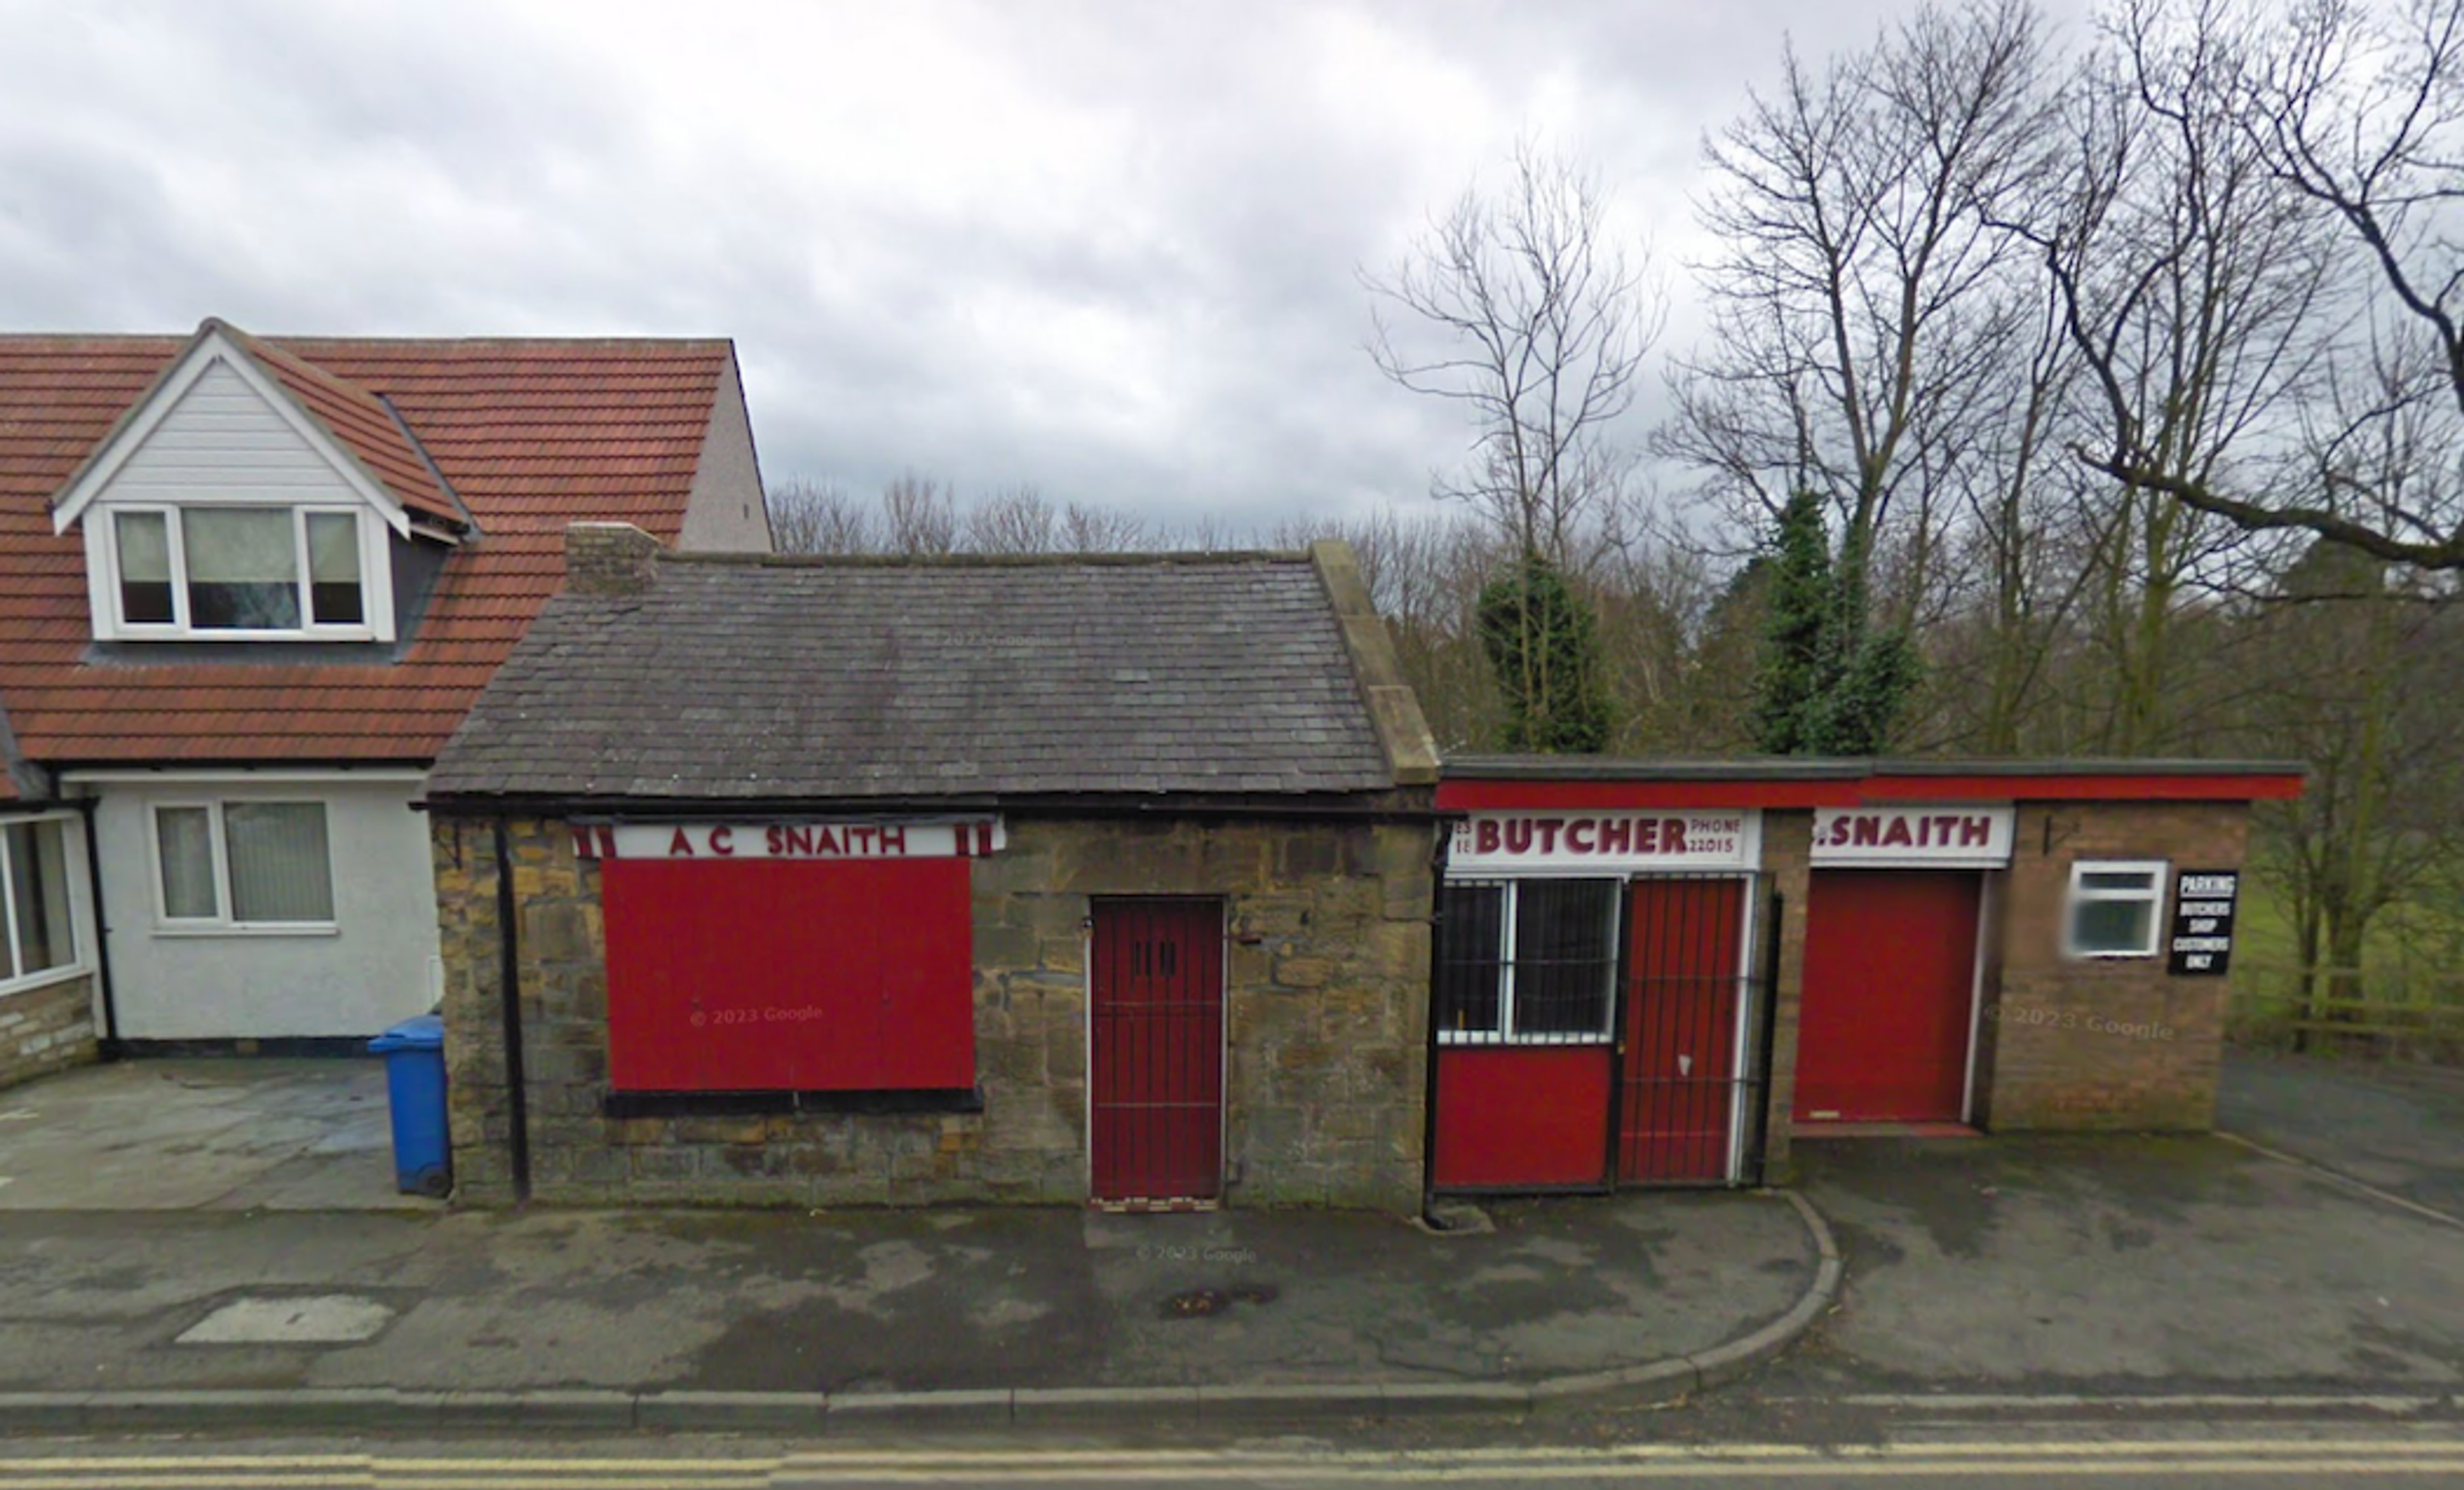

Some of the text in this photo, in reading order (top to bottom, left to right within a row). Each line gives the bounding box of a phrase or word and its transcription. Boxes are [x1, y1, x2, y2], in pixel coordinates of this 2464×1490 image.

[1476, 818, 1688, 855] BUTCHER
[1690, 818, 1741, 834] PHONE
[669, 826, 906, 856] A C SNAITH
[1690, 838, 1734, 853] 22015
